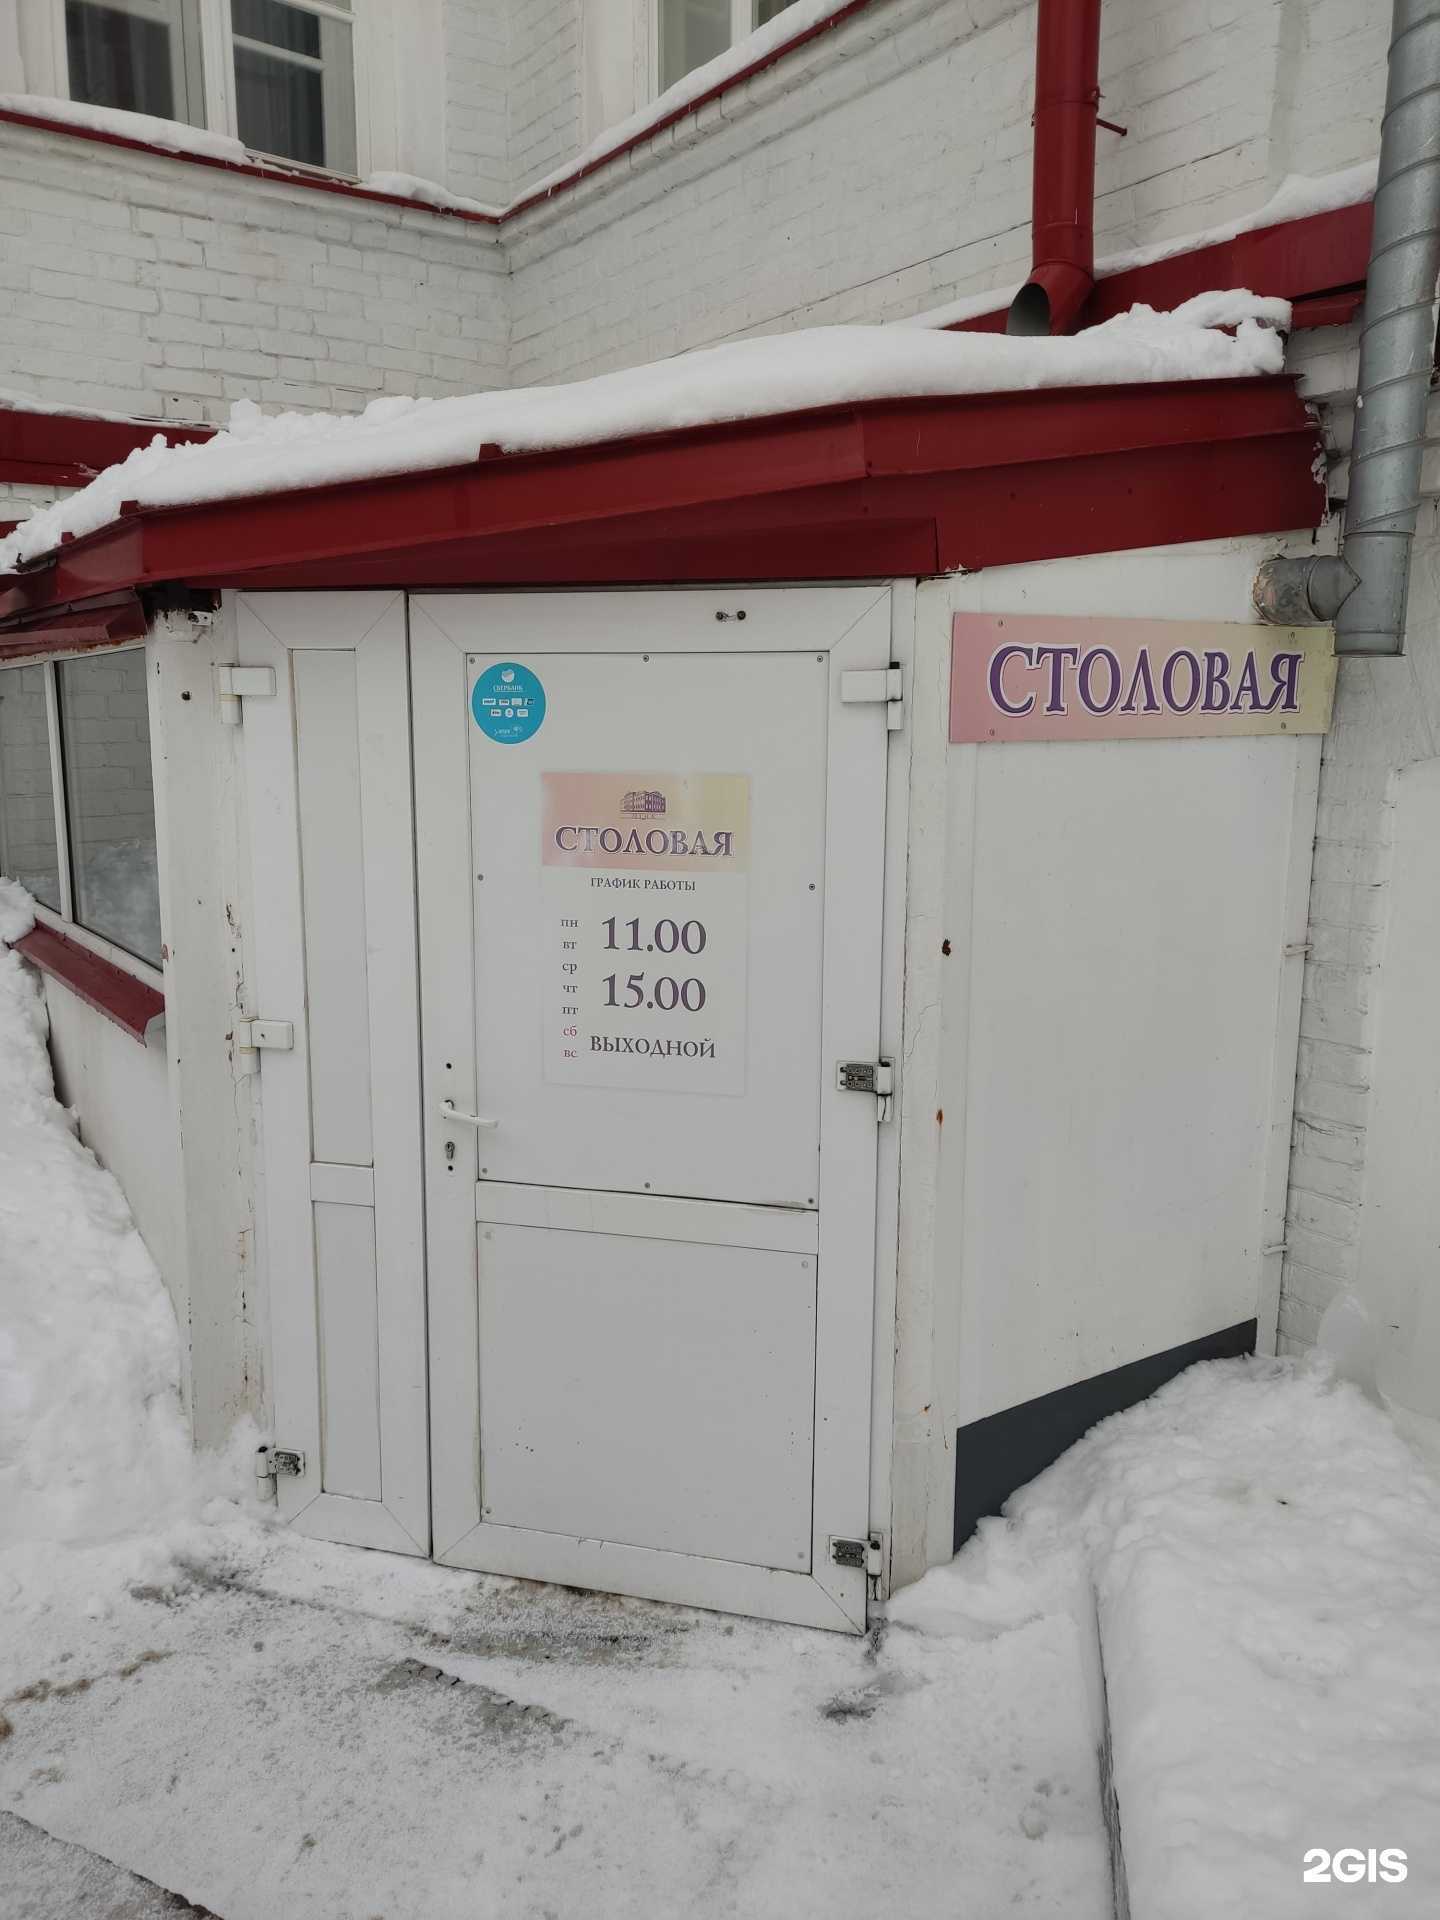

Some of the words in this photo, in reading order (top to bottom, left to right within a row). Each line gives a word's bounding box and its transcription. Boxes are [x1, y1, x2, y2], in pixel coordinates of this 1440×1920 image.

[988, 643, 1304, 715] СТОЛОВАЯ
[555, 826, 734, 856] СТОЛОВАЯ
[591, 877, 641, 890] ГРАФИК
[644, 879, 697, 891] РАБОТЫ
[601, 915, 707, 955] 11.00
[562, 962, 577, 974] ср
[602, 971, 706, 1012] 15.00
[563, 1025, 577, 1037] сб
[590, 1036, 716, 1058] ВЫХОДНОЙ
